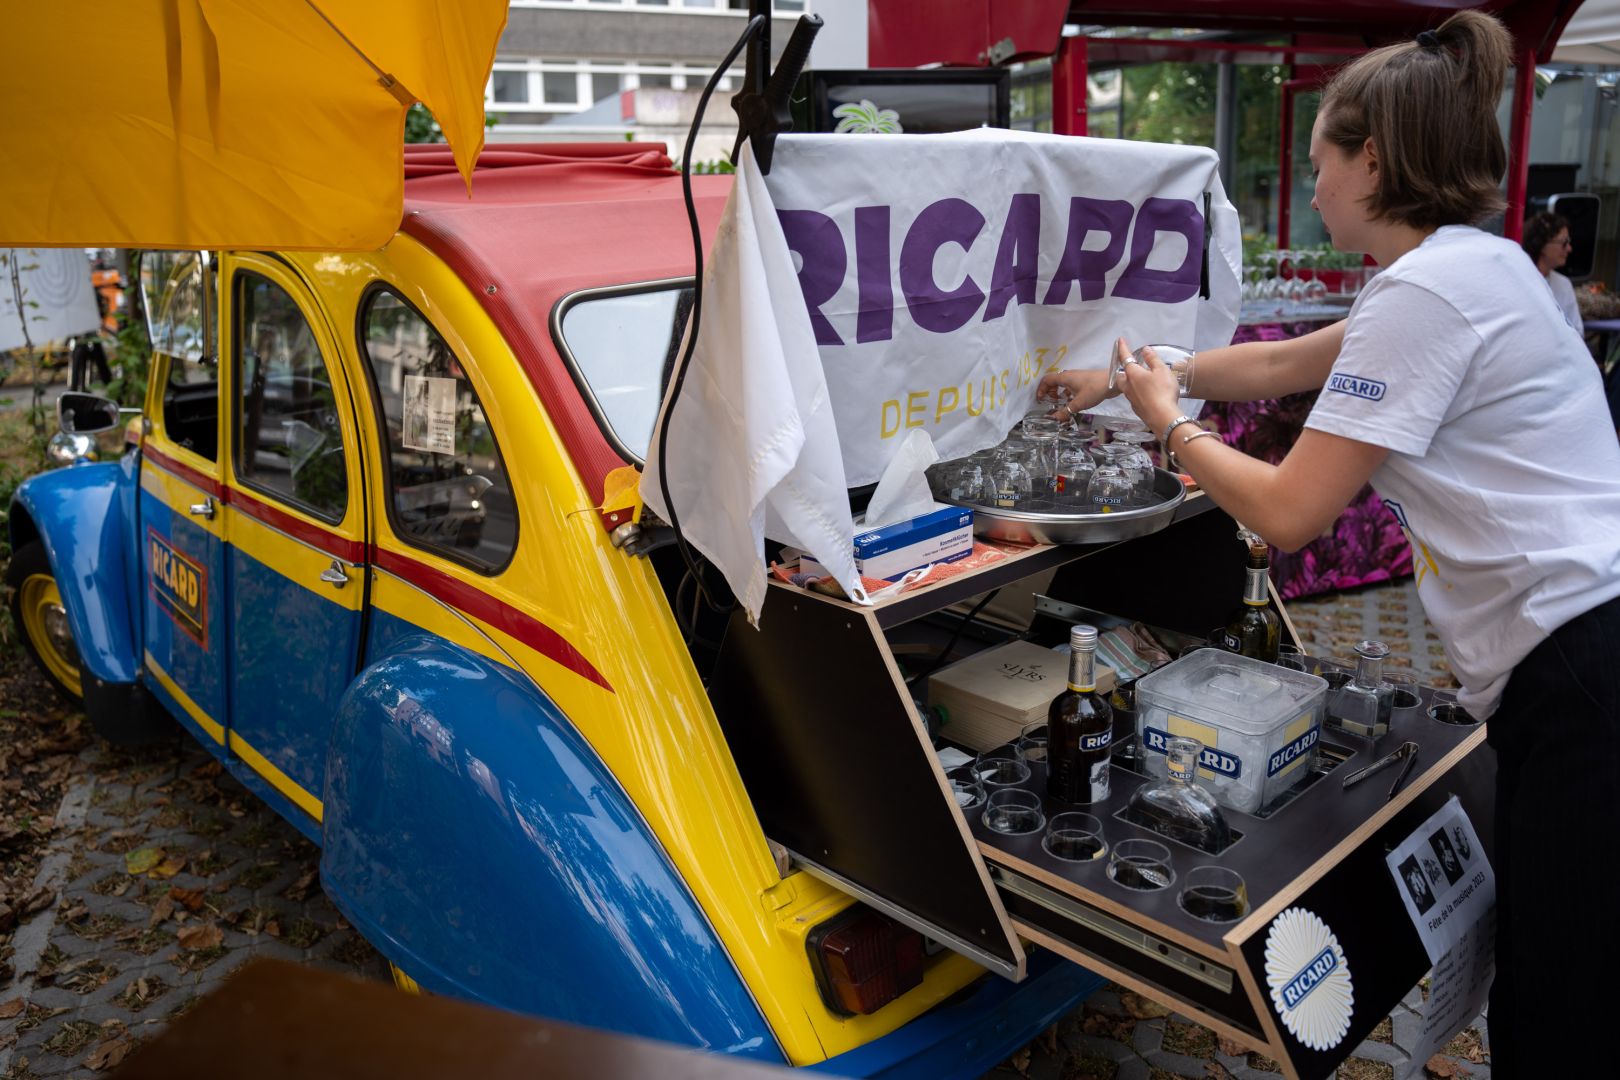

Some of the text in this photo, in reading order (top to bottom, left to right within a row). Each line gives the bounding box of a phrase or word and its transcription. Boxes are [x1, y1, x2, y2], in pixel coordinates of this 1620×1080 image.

[776, 193, 1204, 345] RICARD
[880, 345, 1068, 439] DEPUIS 1932
[1331, 376, 1381, 397] RICARD
[152, 541, 199, 608] RICARD
[1149, 732, 1237, 773] RRD
[1270, 730, 1318, 773] RICARD
[1428, 871, 1486, 932] Fête de la musique 2023
[1284, 953, 1334, 1005] RICARD
